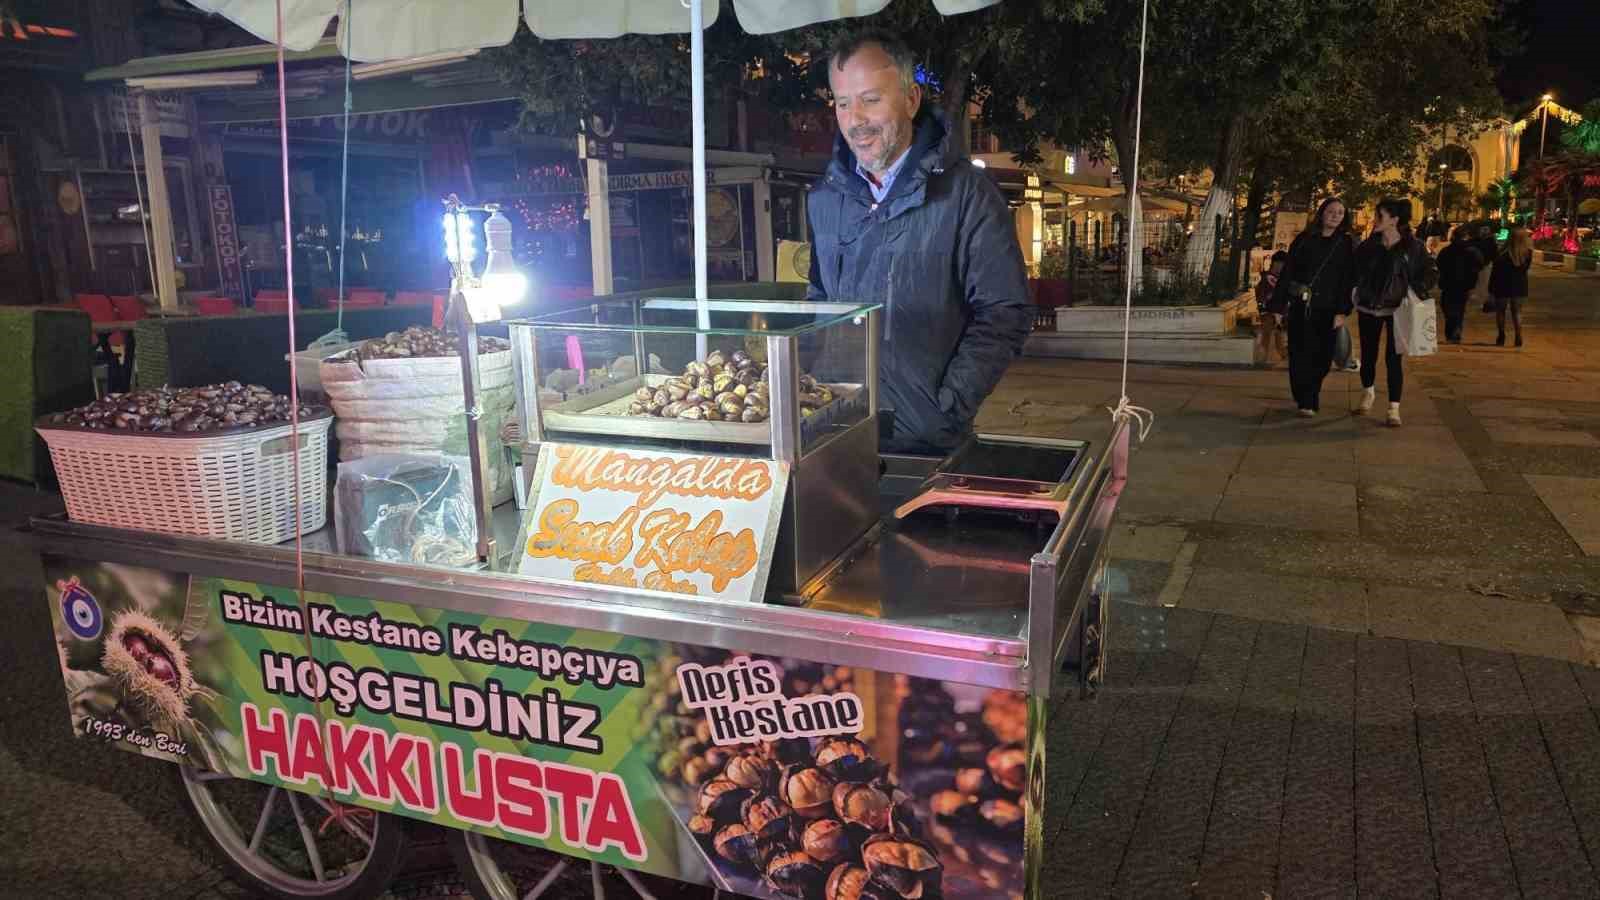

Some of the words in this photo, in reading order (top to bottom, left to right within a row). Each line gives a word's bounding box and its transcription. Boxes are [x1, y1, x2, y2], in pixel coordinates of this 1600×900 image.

[552, 447, 772, 509] Mangalda
[222, 593, 304, 633] Bizim
[311, 612, 442, 653] Kestane
[451, 629, 641, 685] Kebapçıya
[262, 653, 602, 750] HOŞGELDİNİZ
[681, 661, 776, 703] Nefis
[85, 717, 152, 747] 1993'den
[155, 733, 188, 756] Beri
[708, 697, 860, 741] Kestane
[241, 704, 438, 814] HAKKI
[443, 743, 649, 863] USTA
